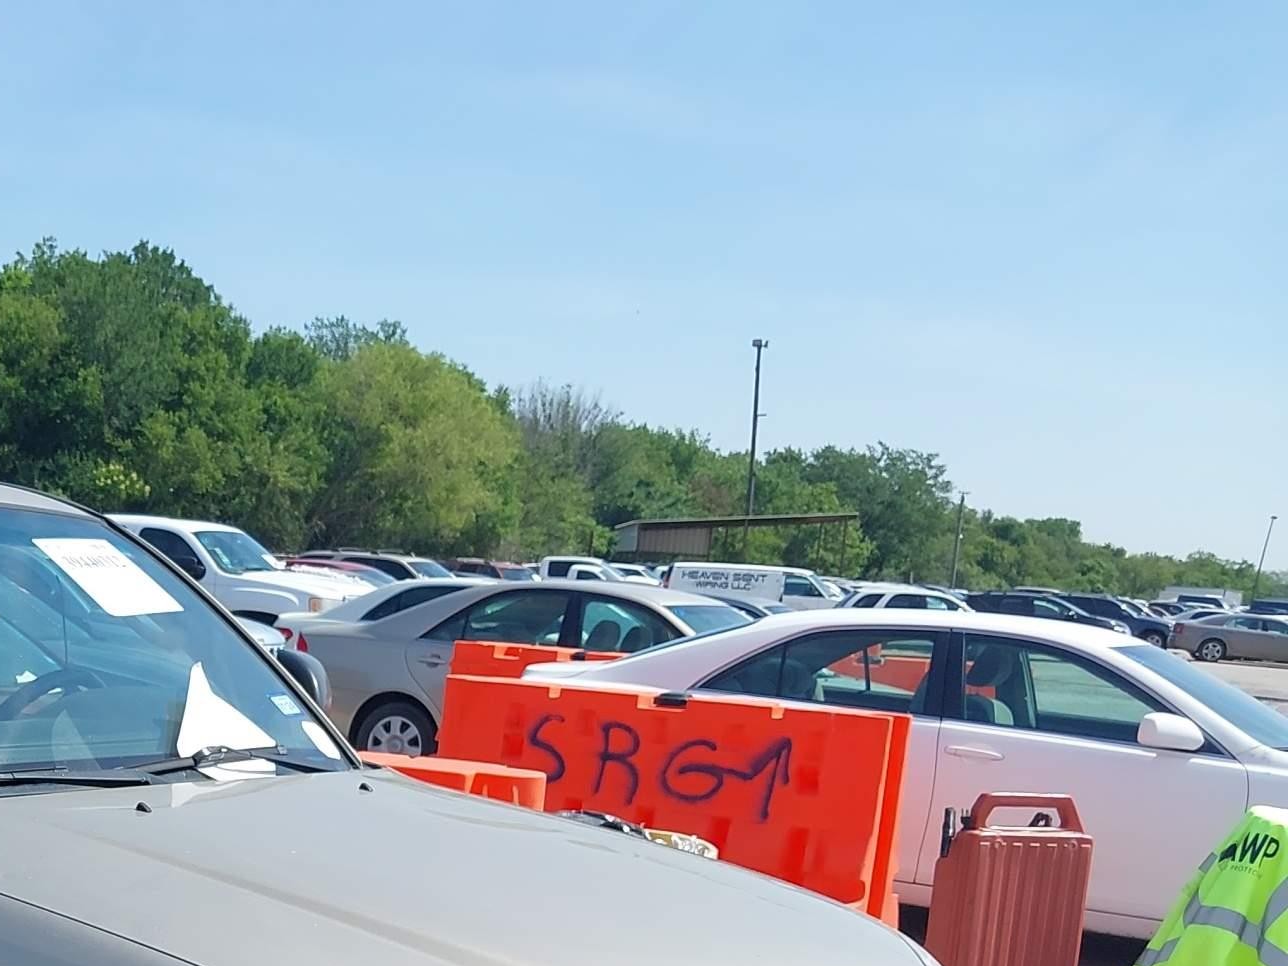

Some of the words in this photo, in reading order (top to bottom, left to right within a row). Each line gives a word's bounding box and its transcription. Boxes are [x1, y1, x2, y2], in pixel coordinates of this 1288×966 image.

[681, 570, 729, 581] HEAVEN
[732, 573, 768, 584] SENT
[731, 582, 752, 591] LLC
